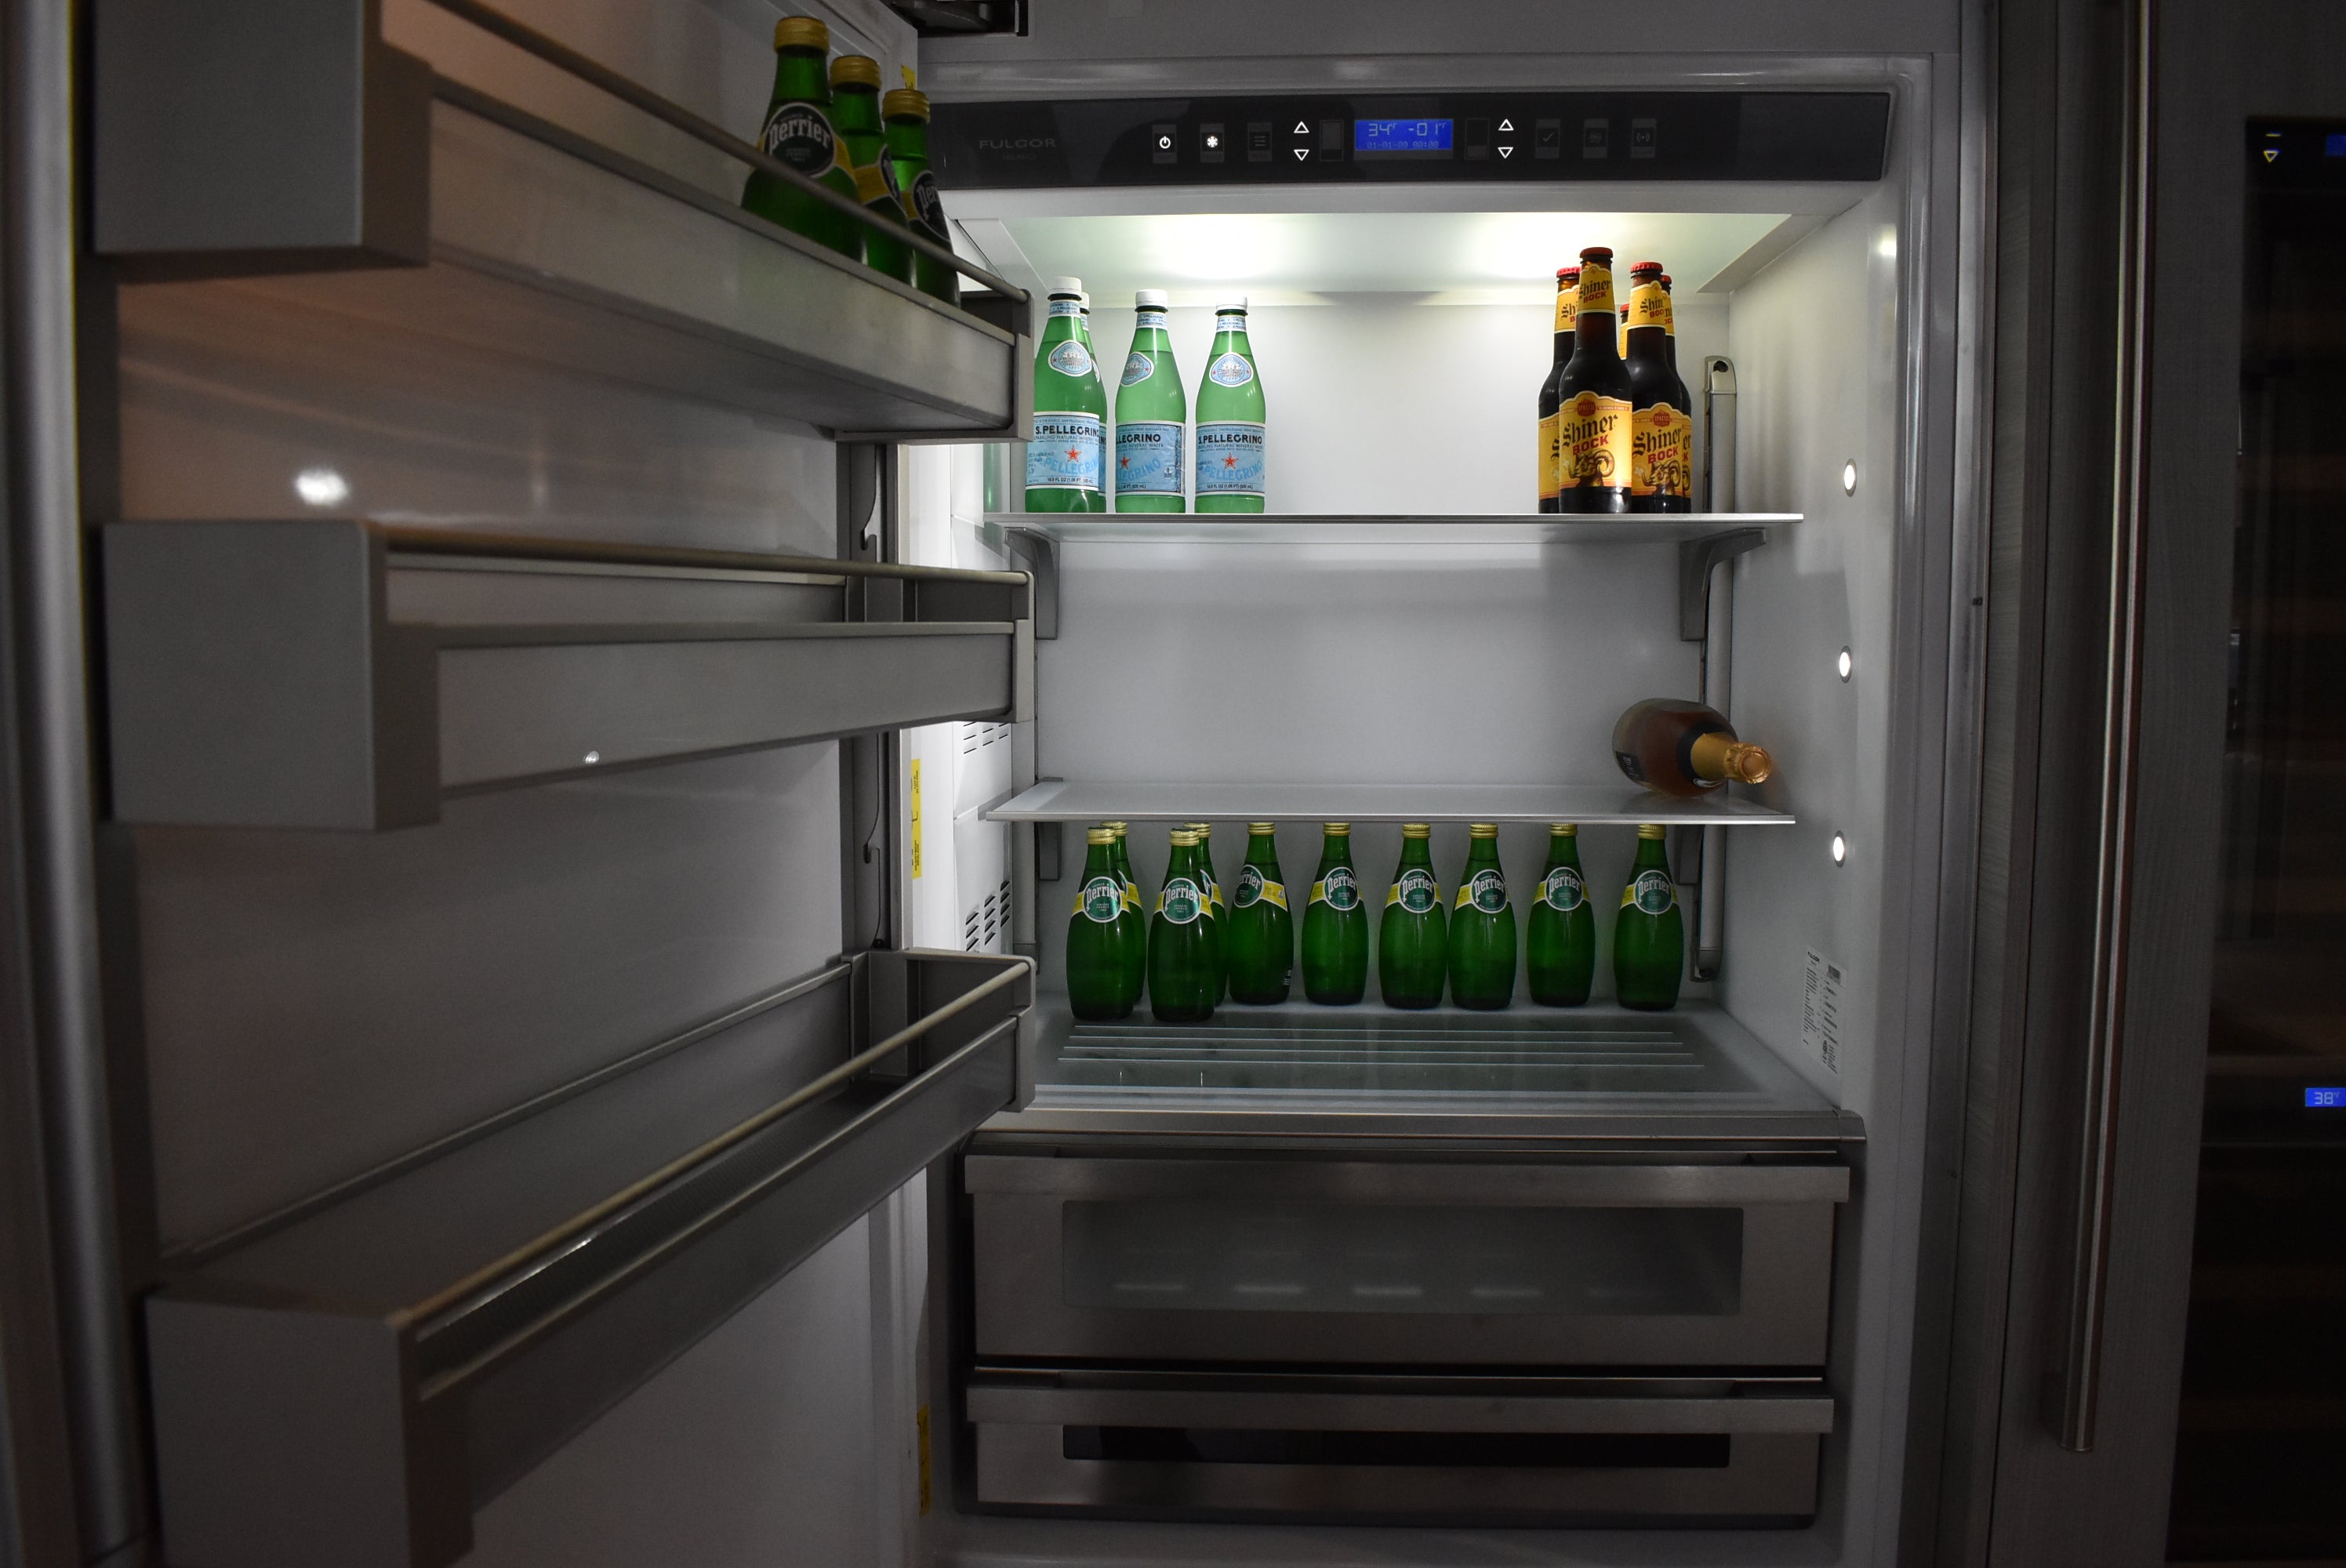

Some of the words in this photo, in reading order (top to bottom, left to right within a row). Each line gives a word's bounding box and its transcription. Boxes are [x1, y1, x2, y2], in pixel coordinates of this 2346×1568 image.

[979, 138, 1056, 150] FULGOR
[1578, 278, 1611, 299] Shiner
[1583, 290, 1607, 303] BOCK
[1640, 295, 1663, 314] Shin
[1650, 310, 1664, 318] BOC
[1116, 434, 1160, 445] LLEGRINO
[1198, 434, 1262, 445] S.PELLEGRINO
[1562, 413, 1618, 448] Shiner
[1572, 434, 1609, 456] BOCK
[1631, 428, 1682, 459] Shiner
[1647, 445, 1679, 464] BOCK
[1241, 872, 1262, 891] rrier
